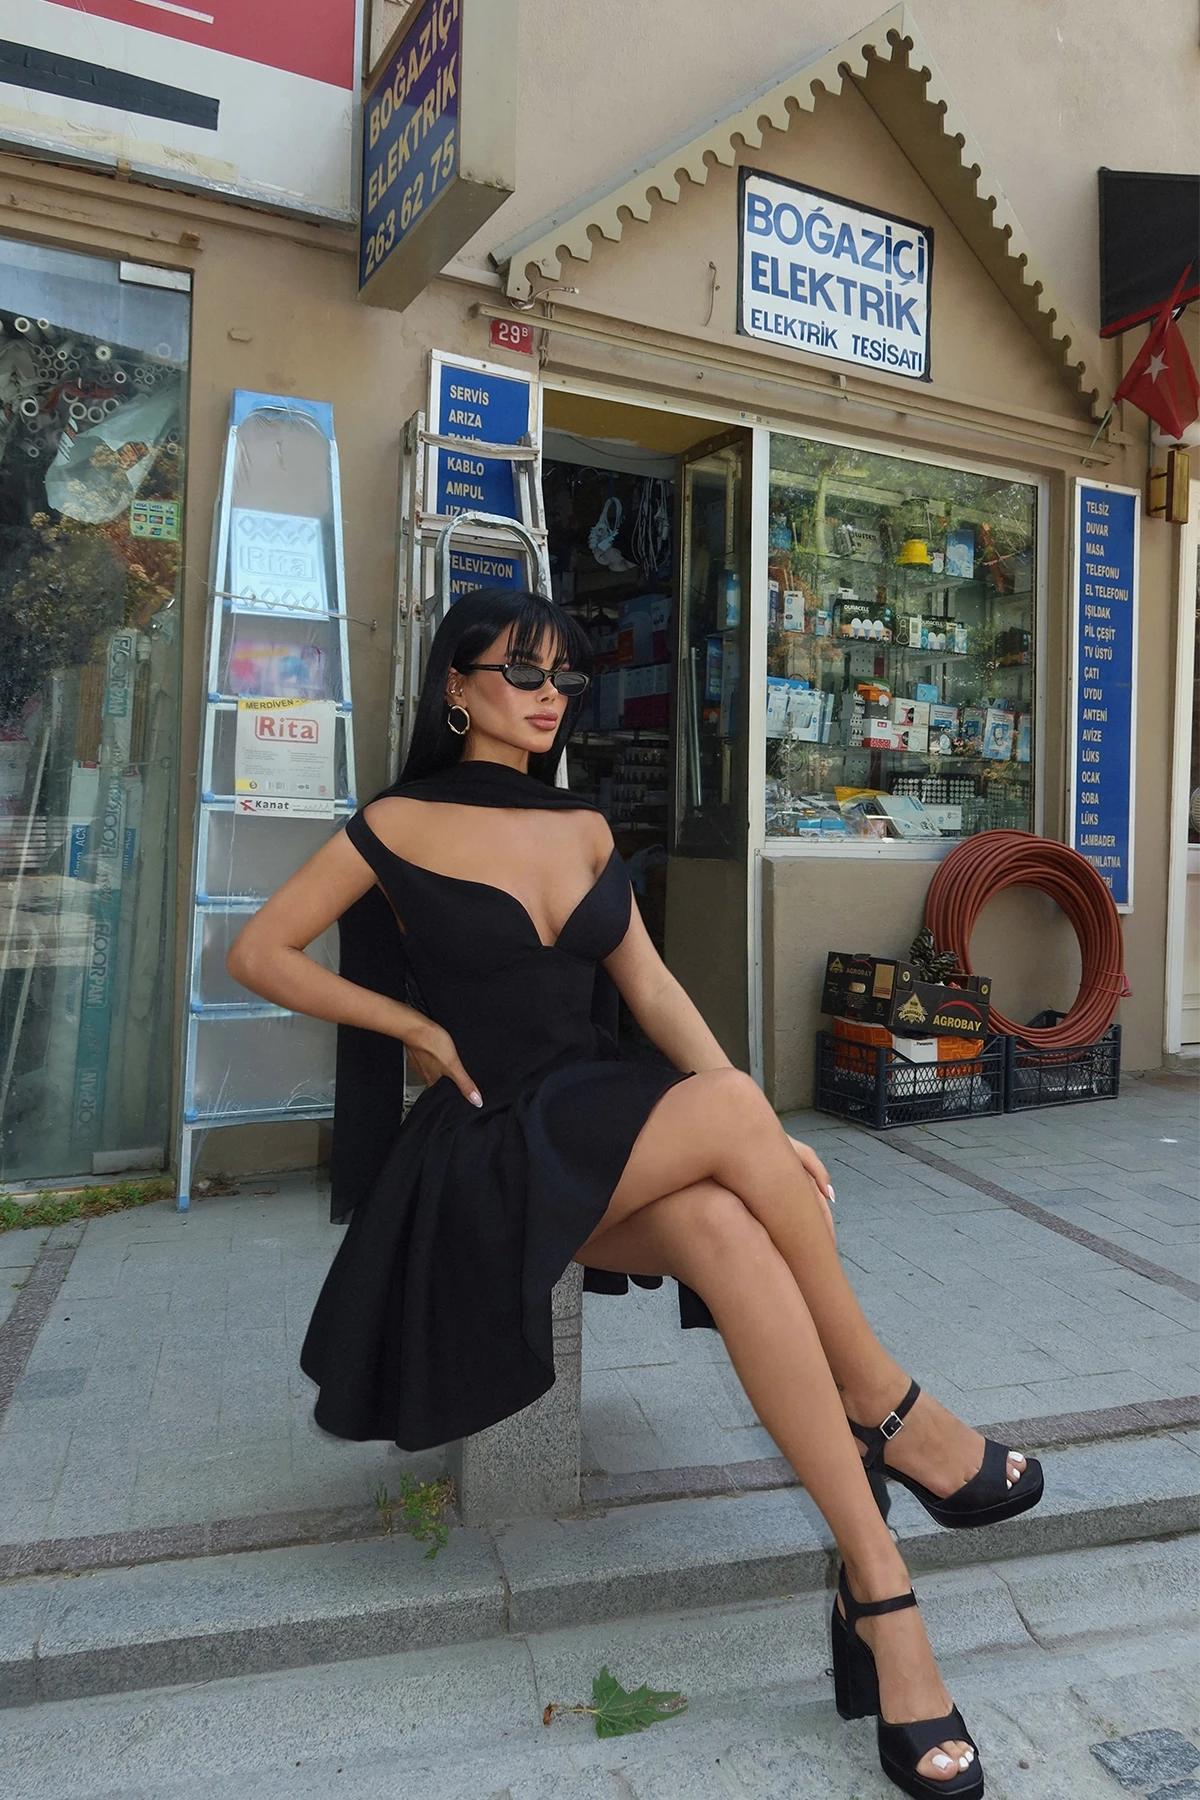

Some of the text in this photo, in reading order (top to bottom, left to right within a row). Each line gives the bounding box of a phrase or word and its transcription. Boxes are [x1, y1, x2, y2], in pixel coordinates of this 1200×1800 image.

[368, 52, 457, 214] ELEKTRİK
[365, 128, 455, 278] 263 62 75
[747, 192, 925, 286] BOĞAZİÇİ
[751, 251, 921, 336] ELEKTRİK
[751, 308, 922, 372] ELEKTRİK TESİSATI
[450, 384, 489, 405] SERVİS
[448, 409, 482, 428] ARIZA
[447, 456, 484, 476] KABLO
[446, 481, 484, 500] AMPUL
[1086, 501, 1109, 516] TELSİZ
[1086, 522, 1108, 537] DUVAR
[1086, 542, 1104, 557] MASA
[451, 555, 513, 578] ELEVİZYON
[1085, 563, 1120, 579] TELEFONU
[451, 580, 482, 595] NTEN
[1085, 584, 1129, 601] EL TELEFONU
[844, 604, 870, 612] DURACELL
[1085, 604, 1111, 619] IŞILDAK
[1084, 623, 1115, 642] PİL ÇEŞİT
[1084, 645, 1112, 660] TV ÜSTÜ
[1084, 666, 1099, 681] ÇATI
[1083, 687, 1102, 701] UYDU
[245, 699, 294, 710] MERDİVEN
[1083, 708, 1107, 722] ANTENİ
[259, 716, 314, 740] Rita
[1082, 727, 1102, 742] AVİZE
[1082, 748, 1100, 763] LÜKS
[1081, 771, 1100, 784] OCAK
[255, 800, 289, 810] Kanat
[1081, 791, 1099, 804] SOBA
[1081, 811, 1098, 825] LÜKS
[76, 827, 87, 847] AC3
[1080, 834, 1115, 847] LAMBADER
[88, 922, 110, 1004] FLOORPAN
[846, 967, 873, 977] AGROBAY
[933, 1014, 982, 1032] AGROBAY
